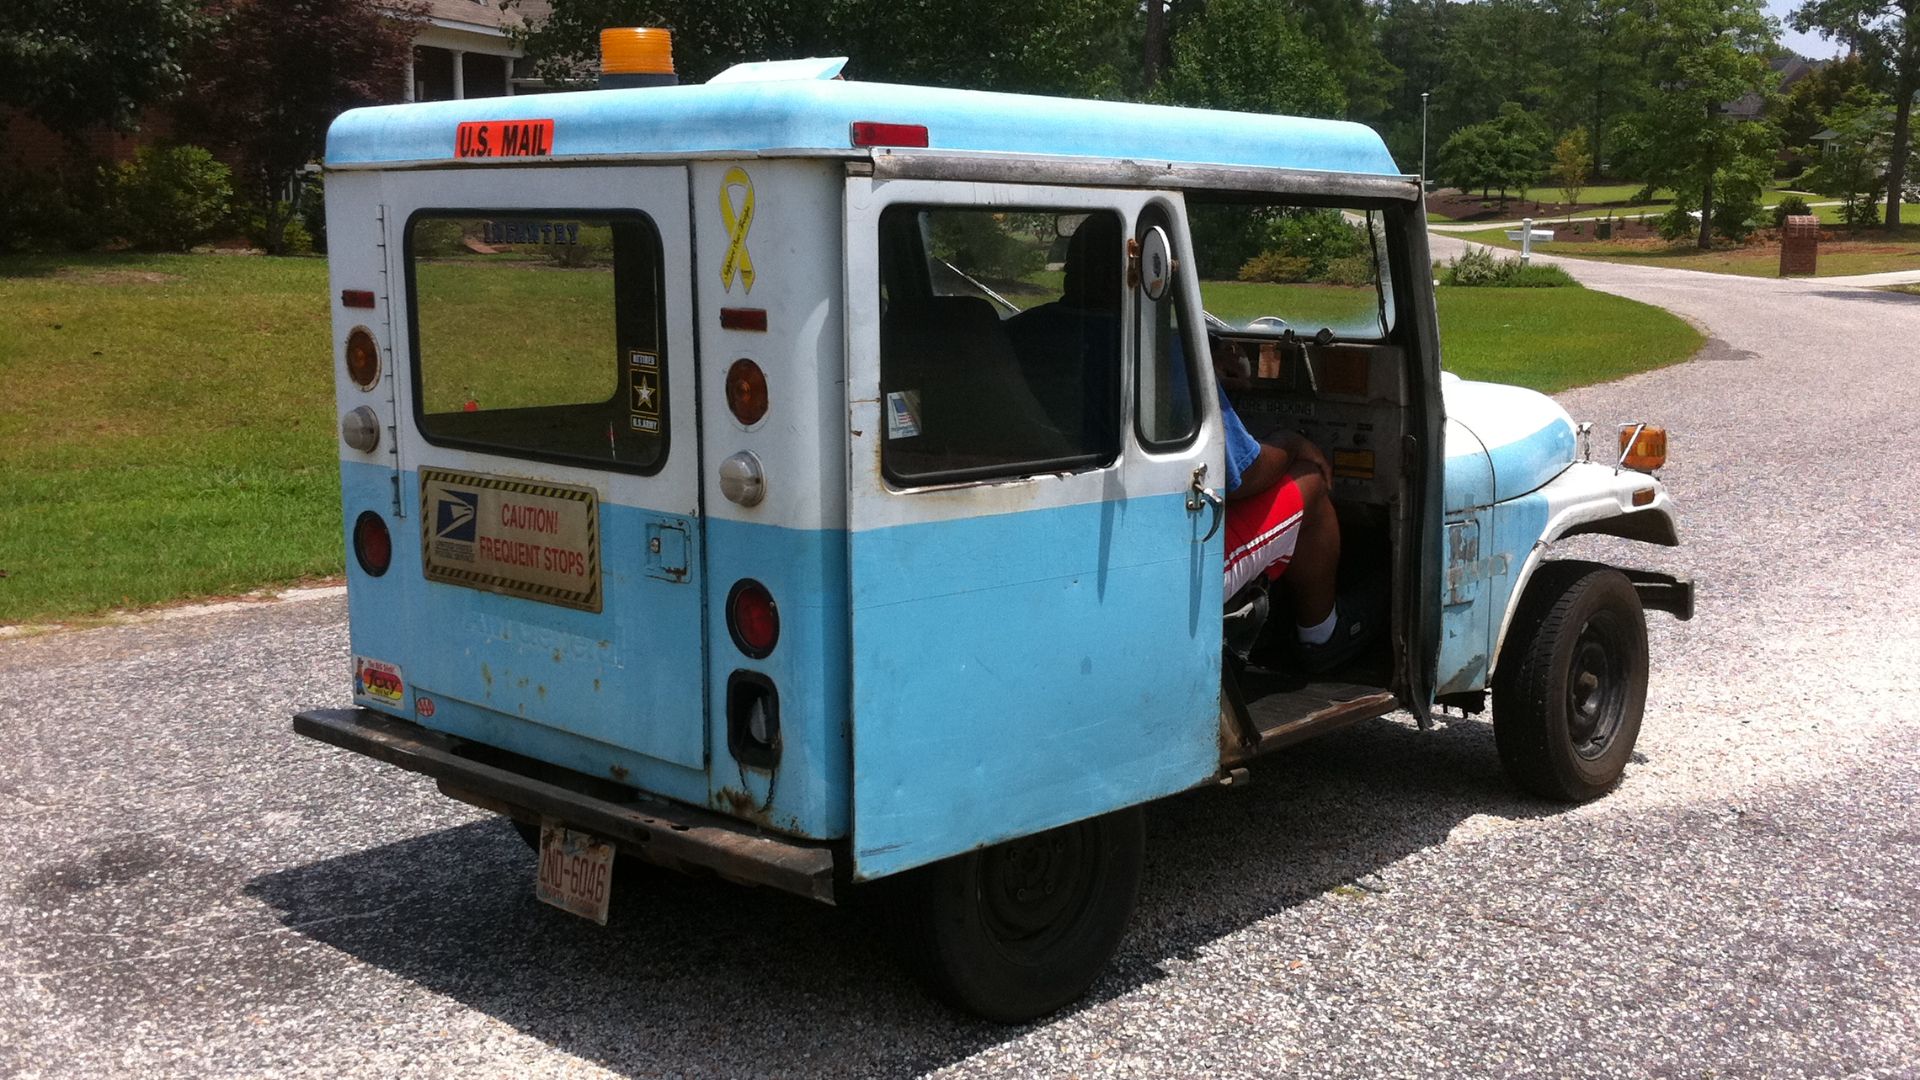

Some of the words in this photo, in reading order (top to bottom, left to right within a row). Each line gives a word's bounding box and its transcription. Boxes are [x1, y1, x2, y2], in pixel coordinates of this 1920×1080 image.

[460, 126, 492, 157] U.S.
[501, 124, 547, 156] MAIL
[483, 222, 579, 245] INFANTRY
[502, 503, 559, 534] CAUTION!
[480, 536, 541, 569] FREQUENT
[543, 547, 585, 577] STOPS
